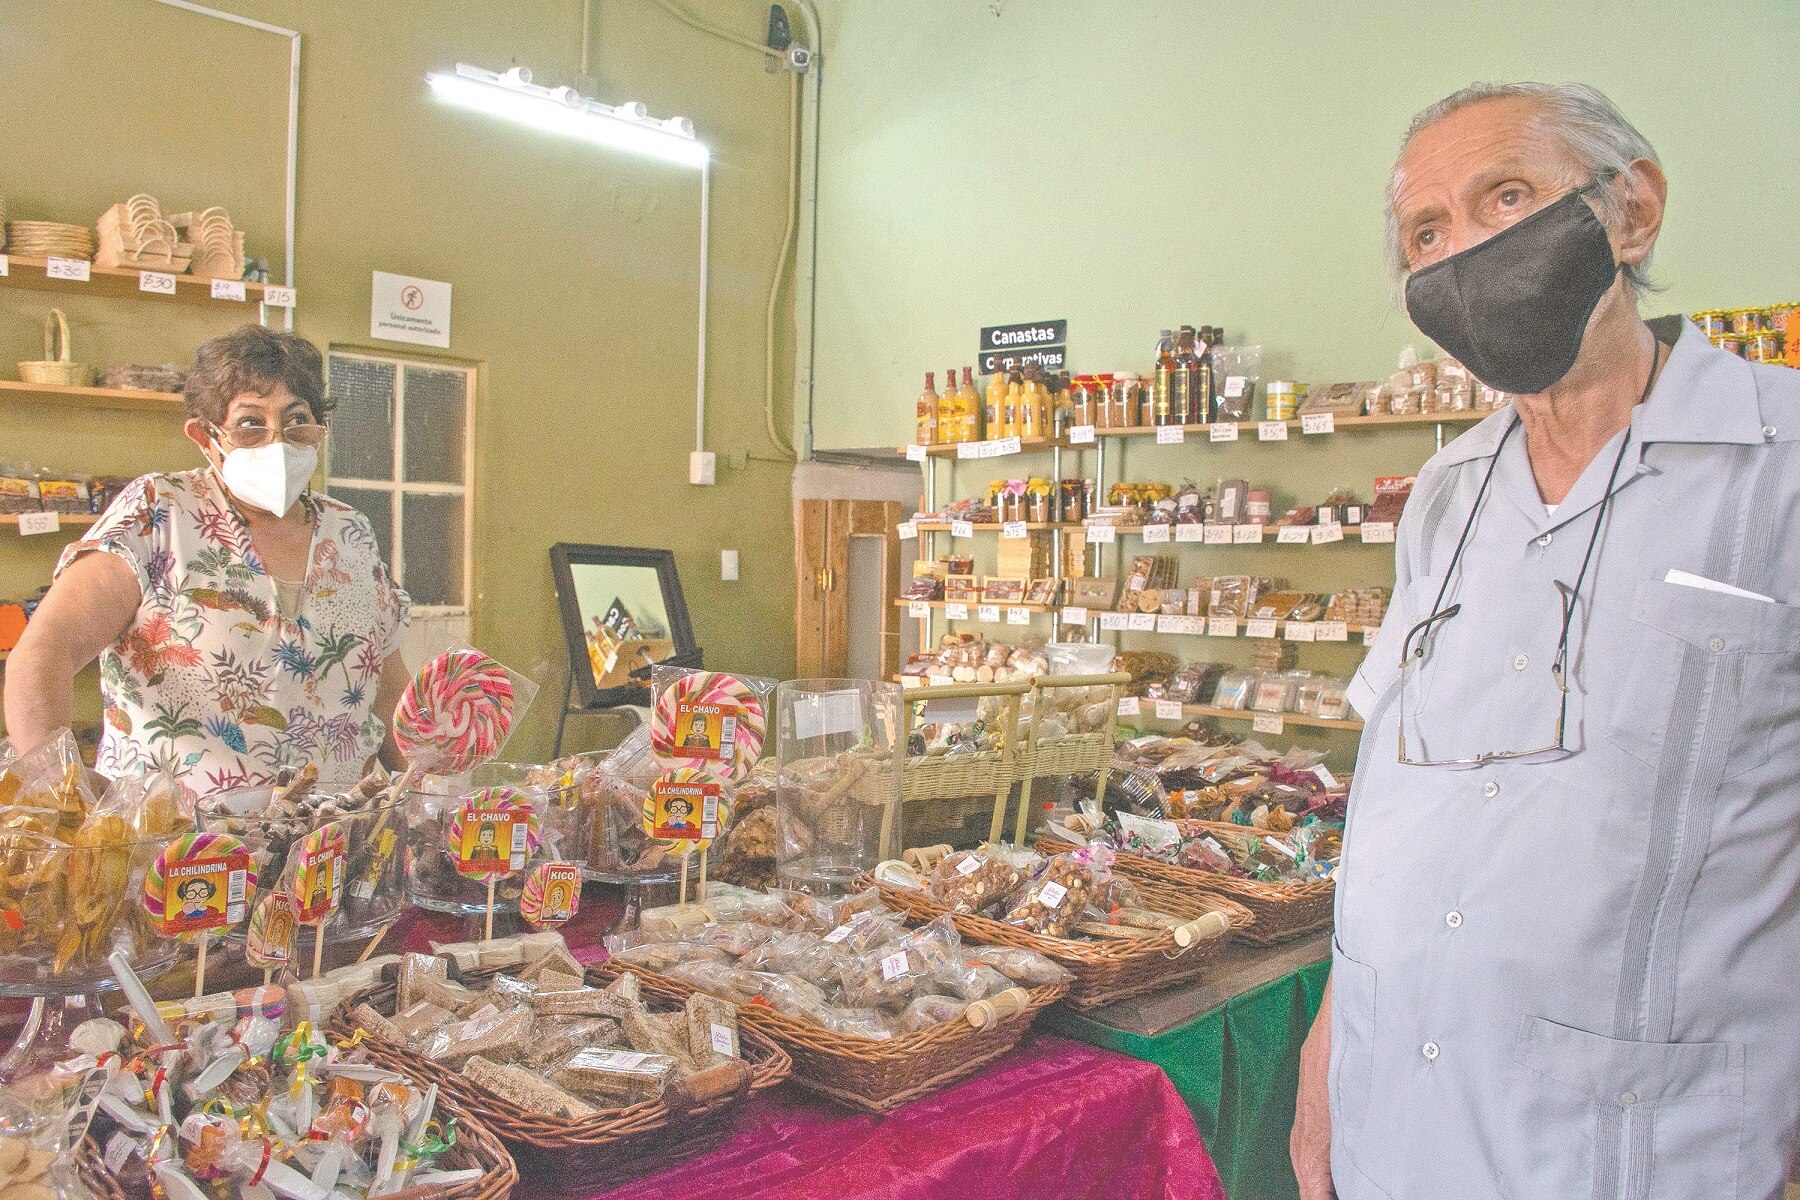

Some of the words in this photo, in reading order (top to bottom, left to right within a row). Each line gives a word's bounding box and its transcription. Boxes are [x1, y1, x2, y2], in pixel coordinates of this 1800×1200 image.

[144, 274, 173, 290] $30
[268, 290, 291, 304] $15
[991, 327, 1055, 346] Canastas
[680, 704, 690, 713] EL
[693, 705, 720, 715] CHAVO
[658, 787, 667, 795] LA
[667, 787, 703, 796] CHILINDRINA
[467, 814, 478, 822] EL
[480, 813, 510, 822] CHAVO
[309, 855, 317, 866] EL
[169, 867, 180, 878] LA
[180, 862, 227, 877] CHILINDRINA
[551, 870, 575, 880] KICO
[275, 899, 290, 911] KIC
